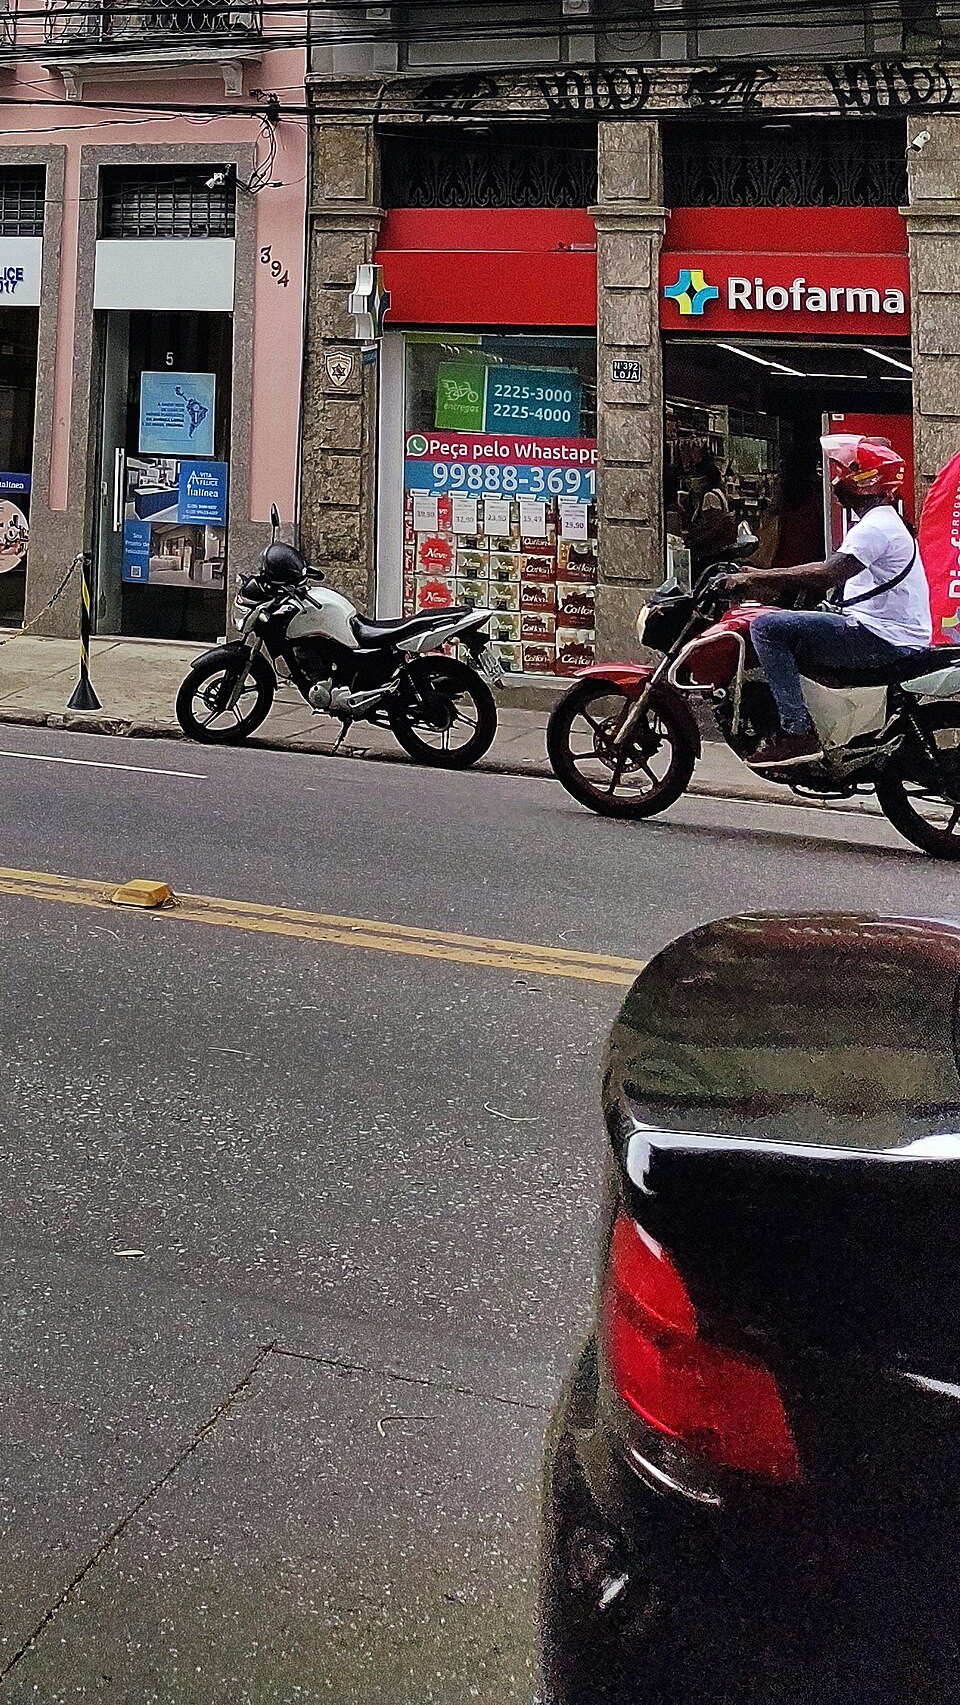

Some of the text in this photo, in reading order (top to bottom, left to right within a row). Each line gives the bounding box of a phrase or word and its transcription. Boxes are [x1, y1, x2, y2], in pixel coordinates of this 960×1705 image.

[728, 277, 905, 313] Riofarma
[165, 352, 174, 366] 5
[613, 370, 638, 380] LOJA
[494, 384, 572, 403] 2225-3000
[443, 404, 480, 413] entregas
[493, 403, 571, 423] 2225-4000
[429, 439, 468, 459] Peça
[473, 440, 510, 459] pelo
[433, 462, 596, 494] 99888-3691
